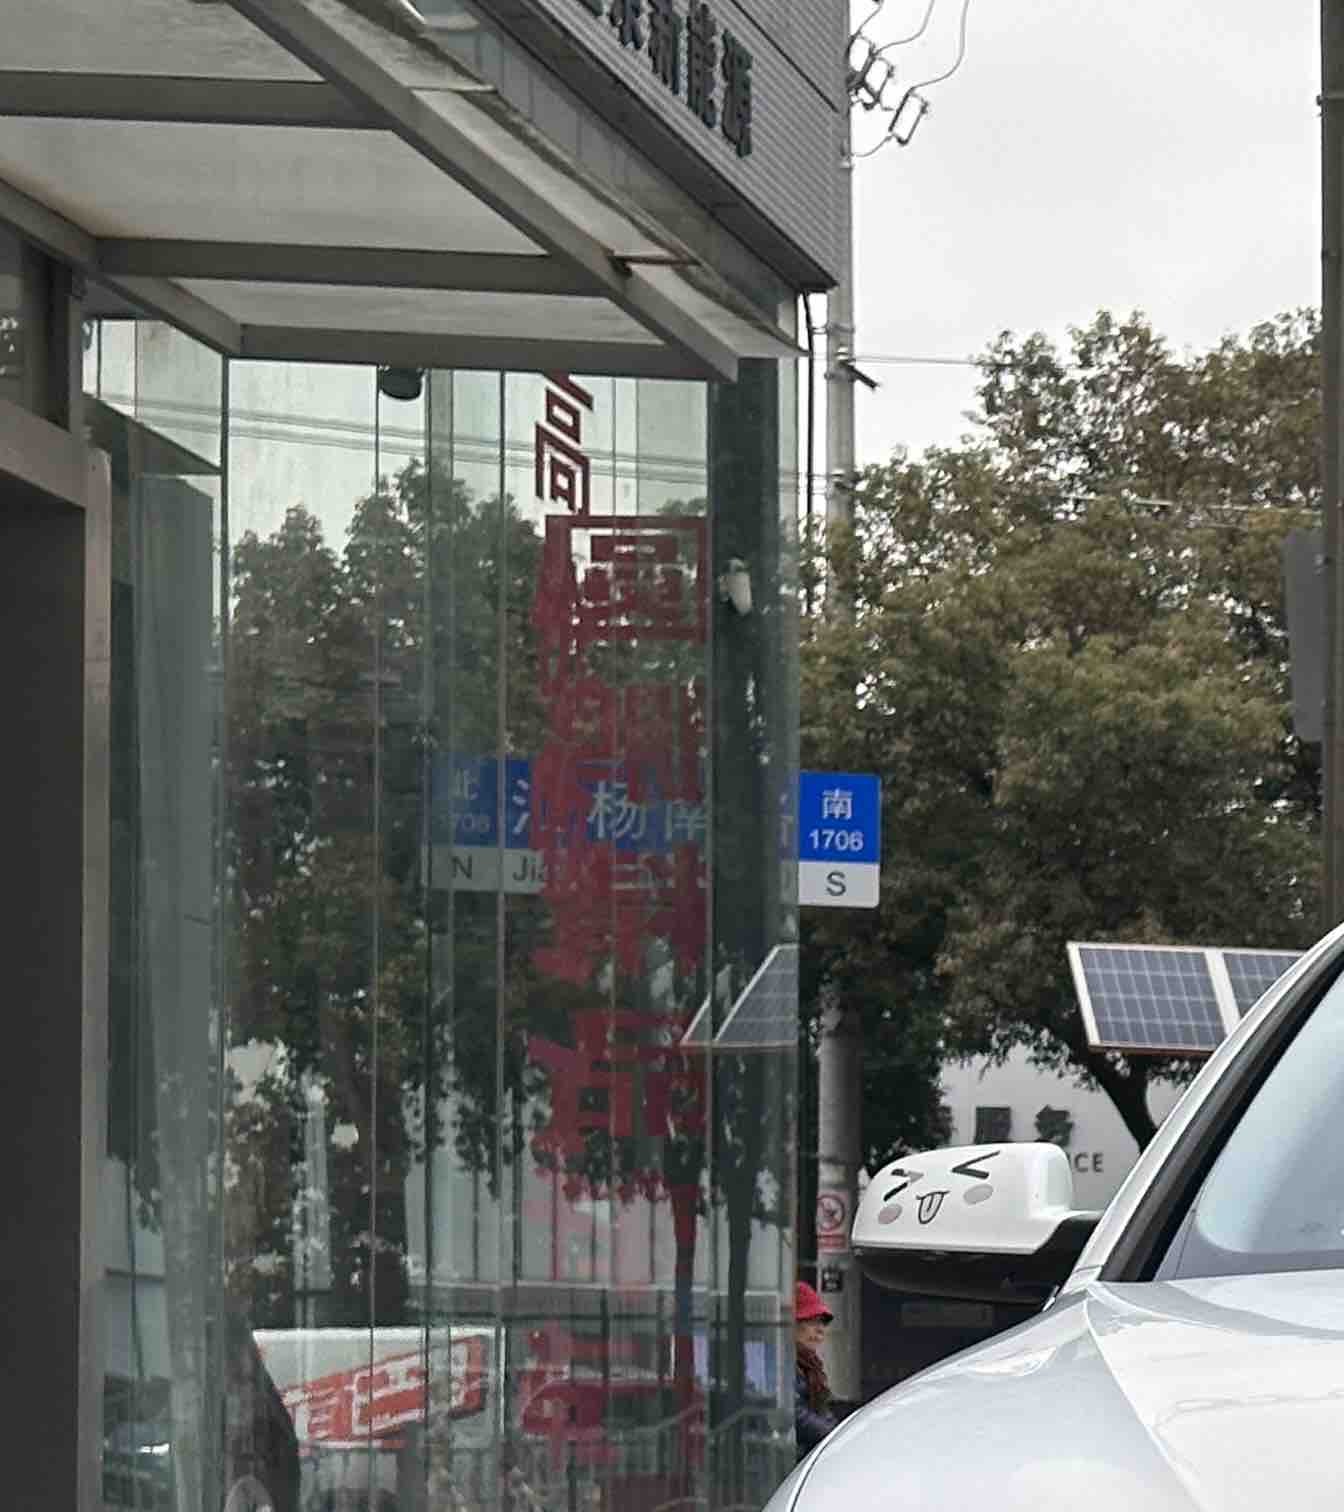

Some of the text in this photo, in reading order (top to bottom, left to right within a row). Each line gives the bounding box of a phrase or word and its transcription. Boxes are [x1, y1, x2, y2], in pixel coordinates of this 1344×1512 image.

[822, 786, 854, 820] 南
[807, 828, 865, 852] 1706
[451, 855, 473, 881] N
[825, 870, 847, 897] S
